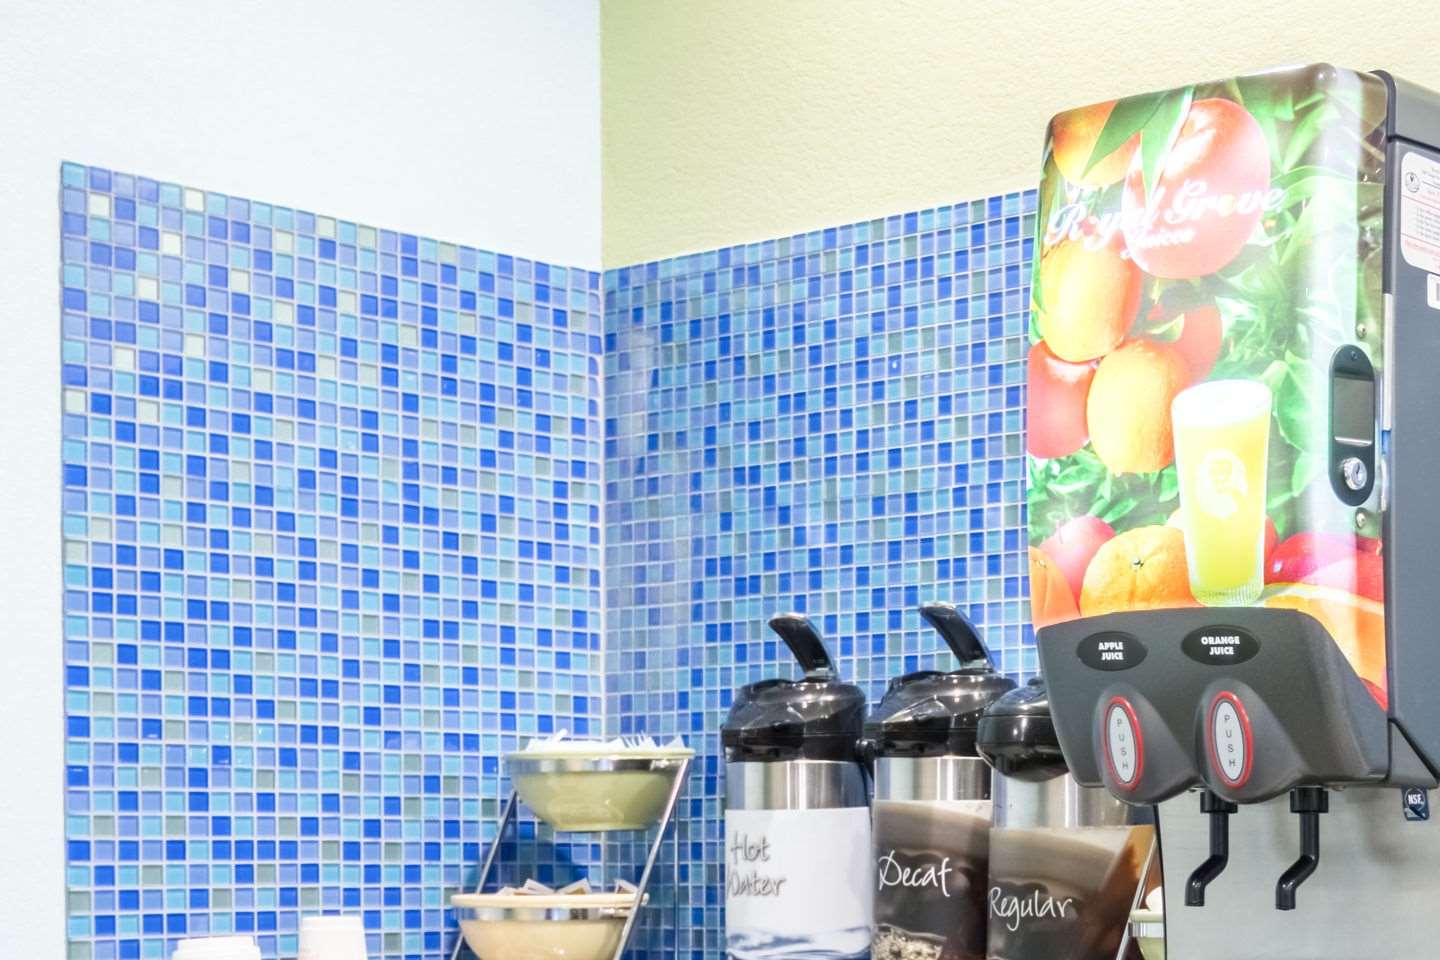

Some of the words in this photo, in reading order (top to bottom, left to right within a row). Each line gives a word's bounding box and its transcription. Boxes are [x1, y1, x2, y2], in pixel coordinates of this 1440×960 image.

[1098, 641, 1124, 651] APPLE
[1101, 651, 1124, 661] JUICE
[1200, 635, 1241, 646] ORANGE
[1209, 645, 1235, 656] JUICE
[1116, 718, 1129, 771] PUSH
[1224, 713, 1237, 768] PUSH
[730, 831, 772, 865] Hot
[877, 849, 953, 898] Decaf
[987, 885, 1073, 932] Regular
